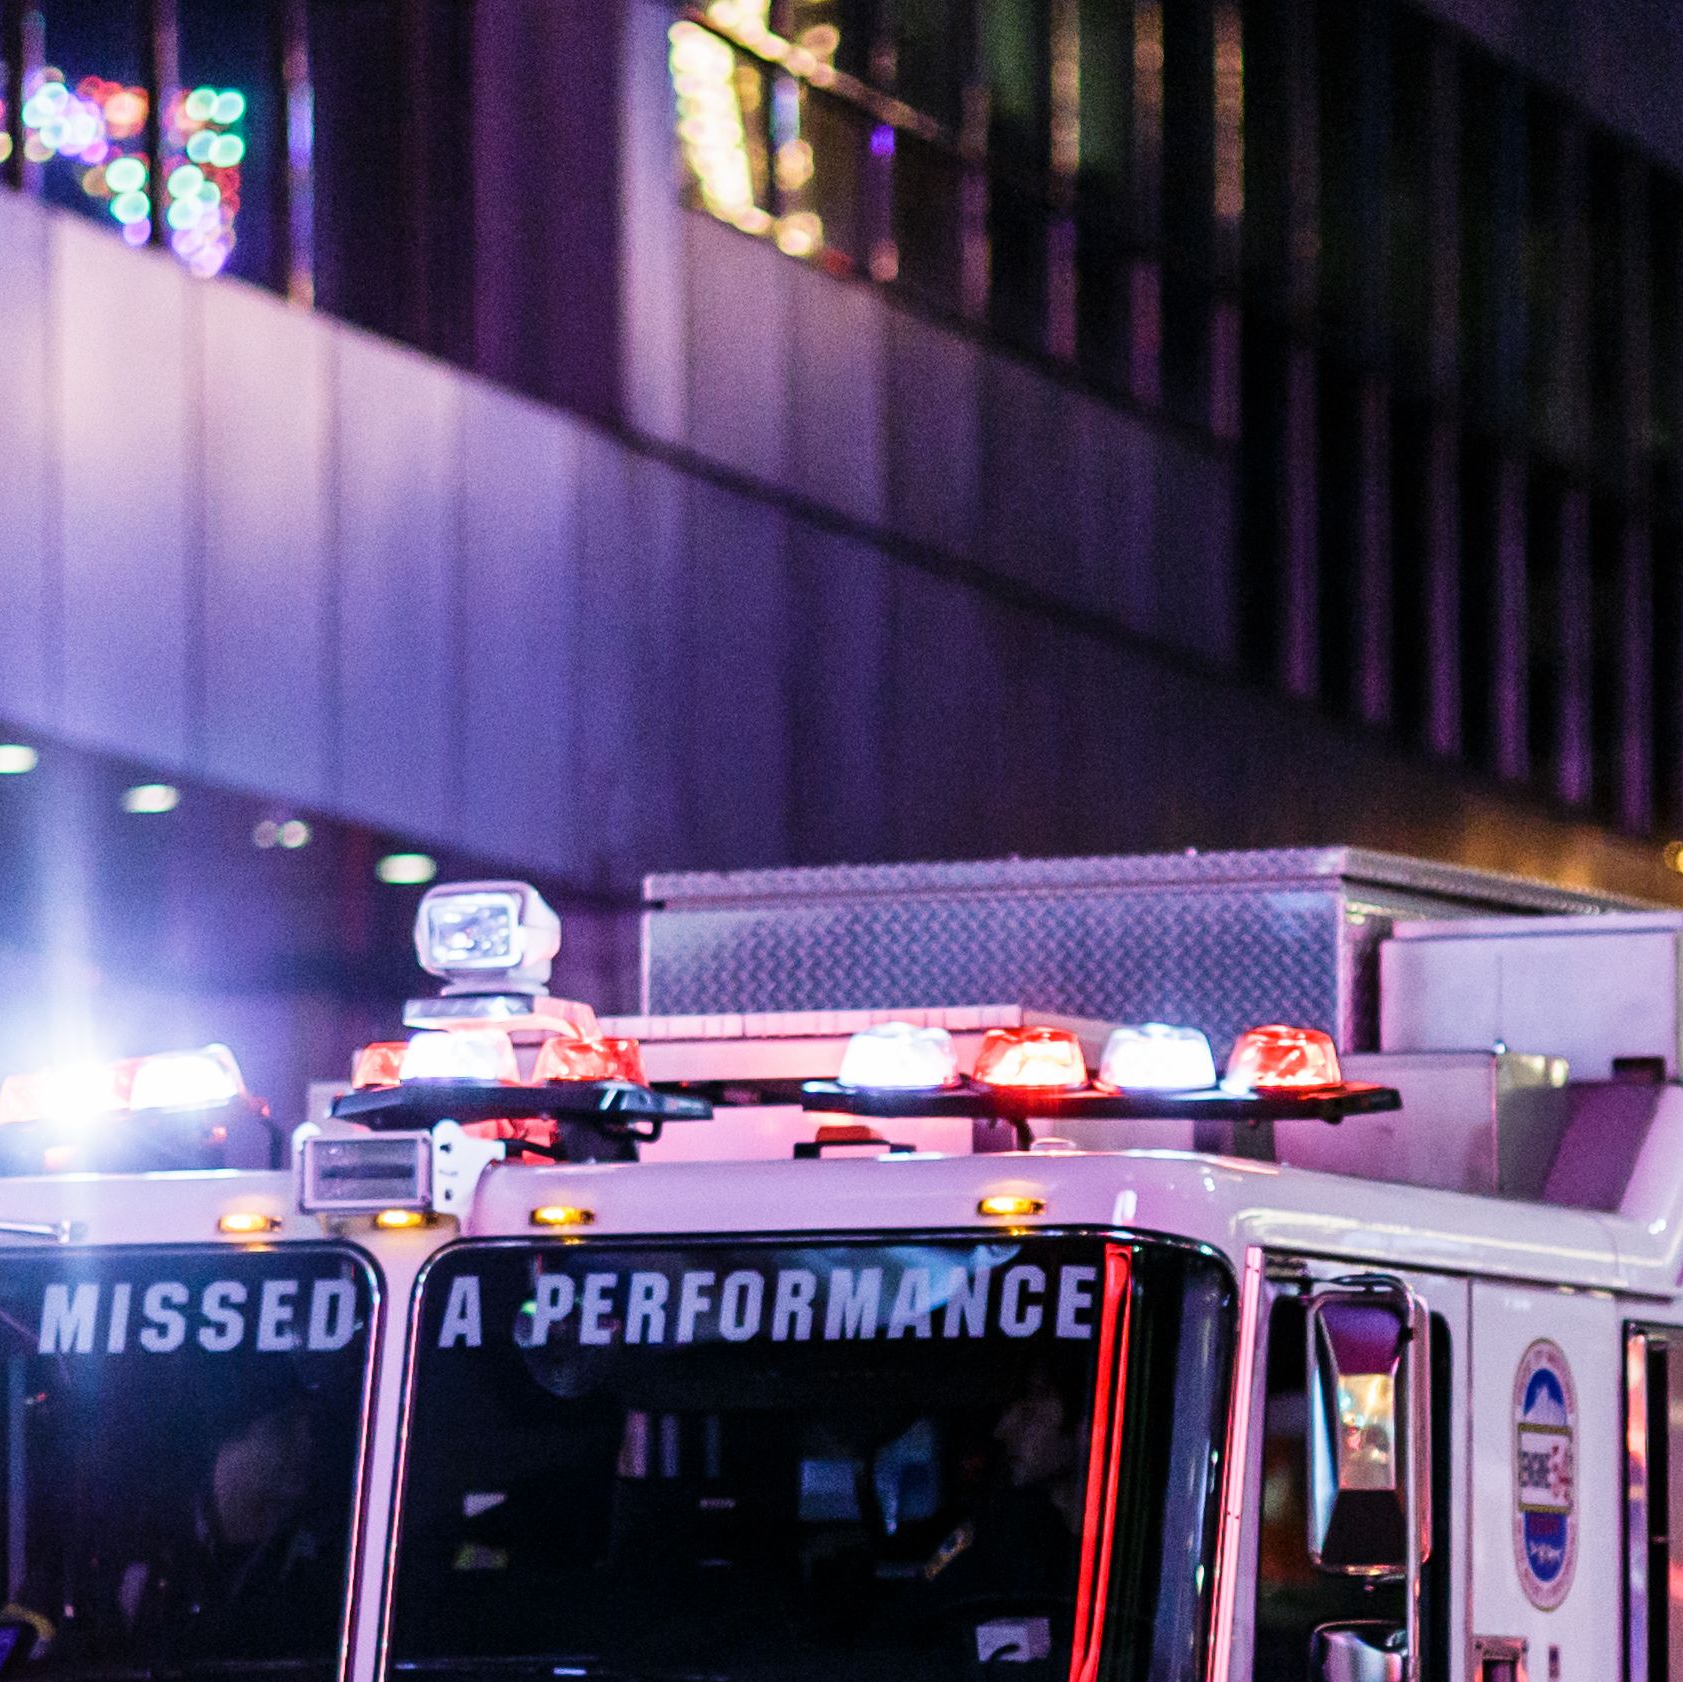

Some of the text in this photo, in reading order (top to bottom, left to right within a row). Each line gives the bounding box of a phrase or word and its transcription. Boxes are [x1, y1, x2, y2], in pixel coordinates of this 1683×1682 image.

[38, 1278, 358, 1354] MISSED
[438, 1276, 483, 1347] A
[529, 1264, 1099, 1347] PERFORMANCE
